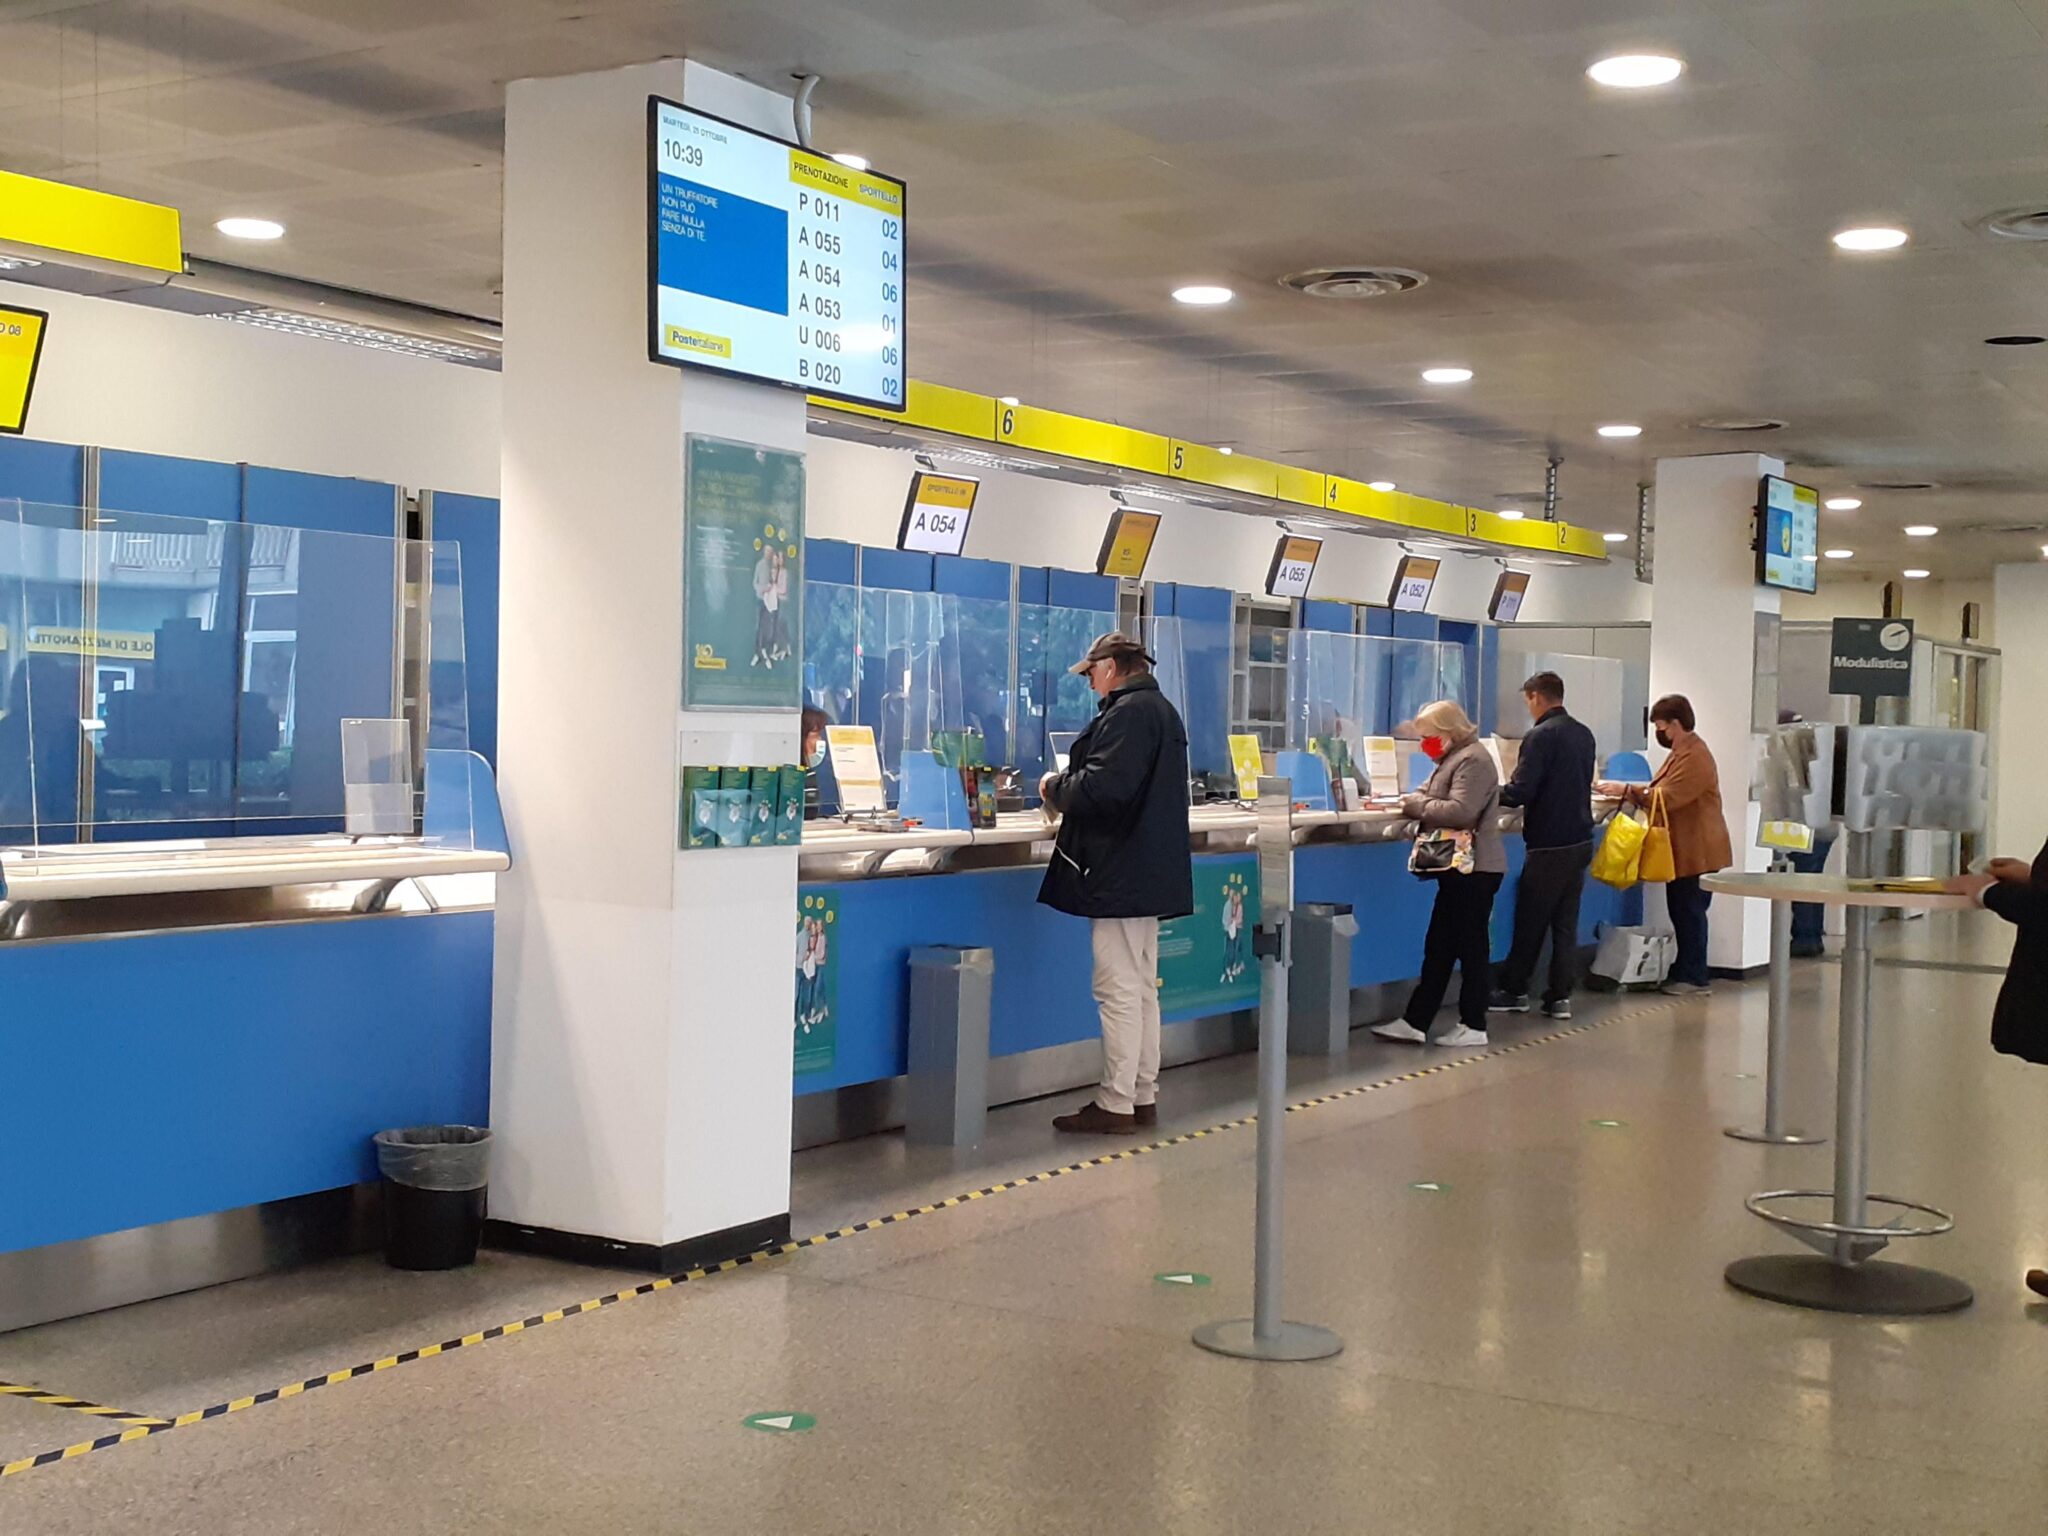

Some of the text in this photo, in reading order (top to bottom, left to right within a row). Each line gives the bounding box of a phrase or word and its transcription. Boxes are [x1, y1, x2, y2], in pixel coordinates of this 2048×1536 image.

[664, 138, 703, 167] 10:39
[794, 162, 898, 204] PRENOTAZIONE SPORTELLO
[799, 192, 898, 240] P 011 02
[798, 225, 898, 272] A 055 04
[798, 259, 898, 303] A 054 06
[798, 292, 896, 335] A 053 01
[799, 325, 898, 366] U 006 06
[799, 358, 898, 397] B 020 02
[1002, 408, 1014, 435] 6
[1173, 446, 1184, 470] 5
[1329, 482, 1337, 503] 4
[914, 512, 957, 534] A 054
[1470, 513, 1477, 532] 3
[1561, 526, 1567, 544] 2
[1279, 565, 1288, 580] A
[1401, 583, 1408, 595] A
[1834, 655, 1908, 670] Modulistica
